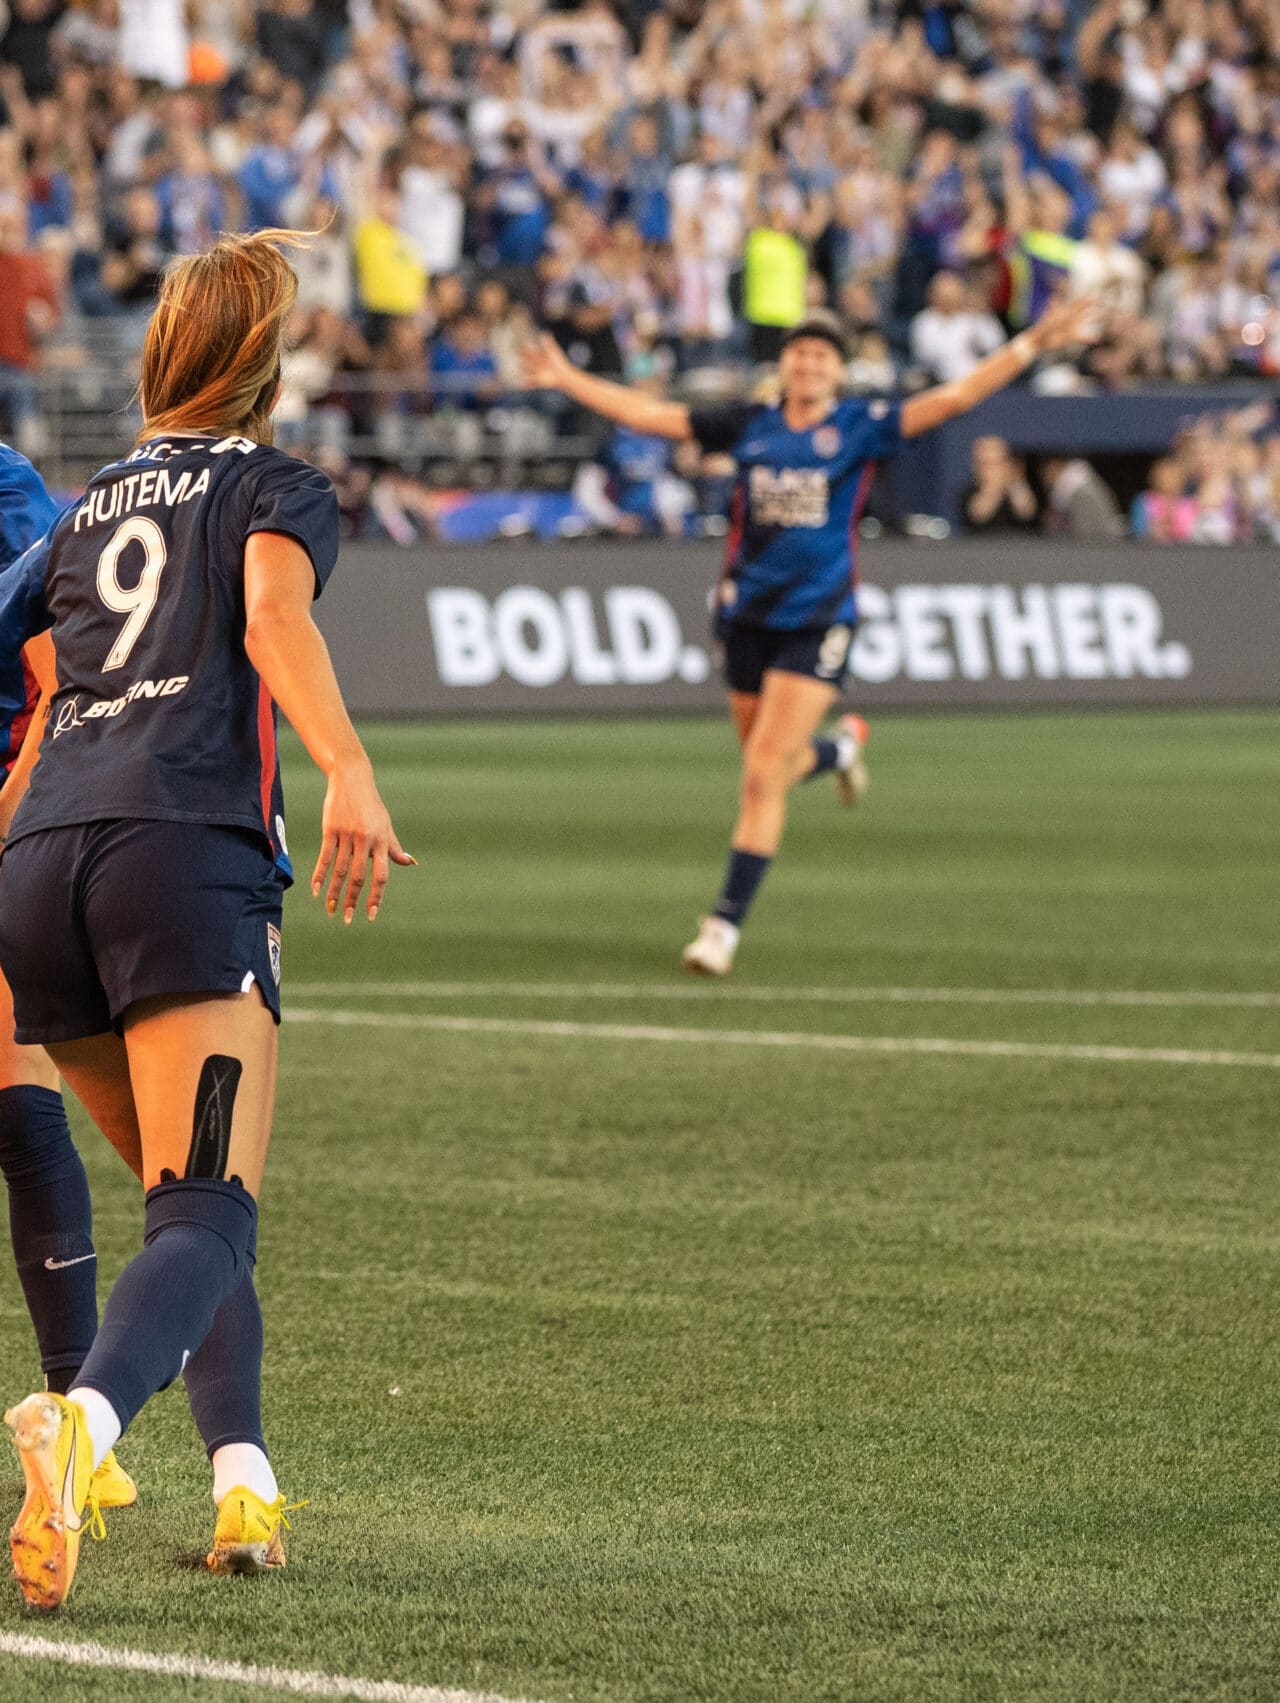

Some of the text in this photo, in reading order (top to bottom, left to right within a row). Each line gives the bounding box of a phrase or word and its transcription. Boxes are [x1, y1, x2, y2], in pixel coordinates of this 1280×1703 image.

[74, 468, 210, 532] HUITEMA
[96, 516, 167, 673] 9
[427, 584, 1194, 687] BOLD. GETHER.
[80, 675, 189, 718] BOING
